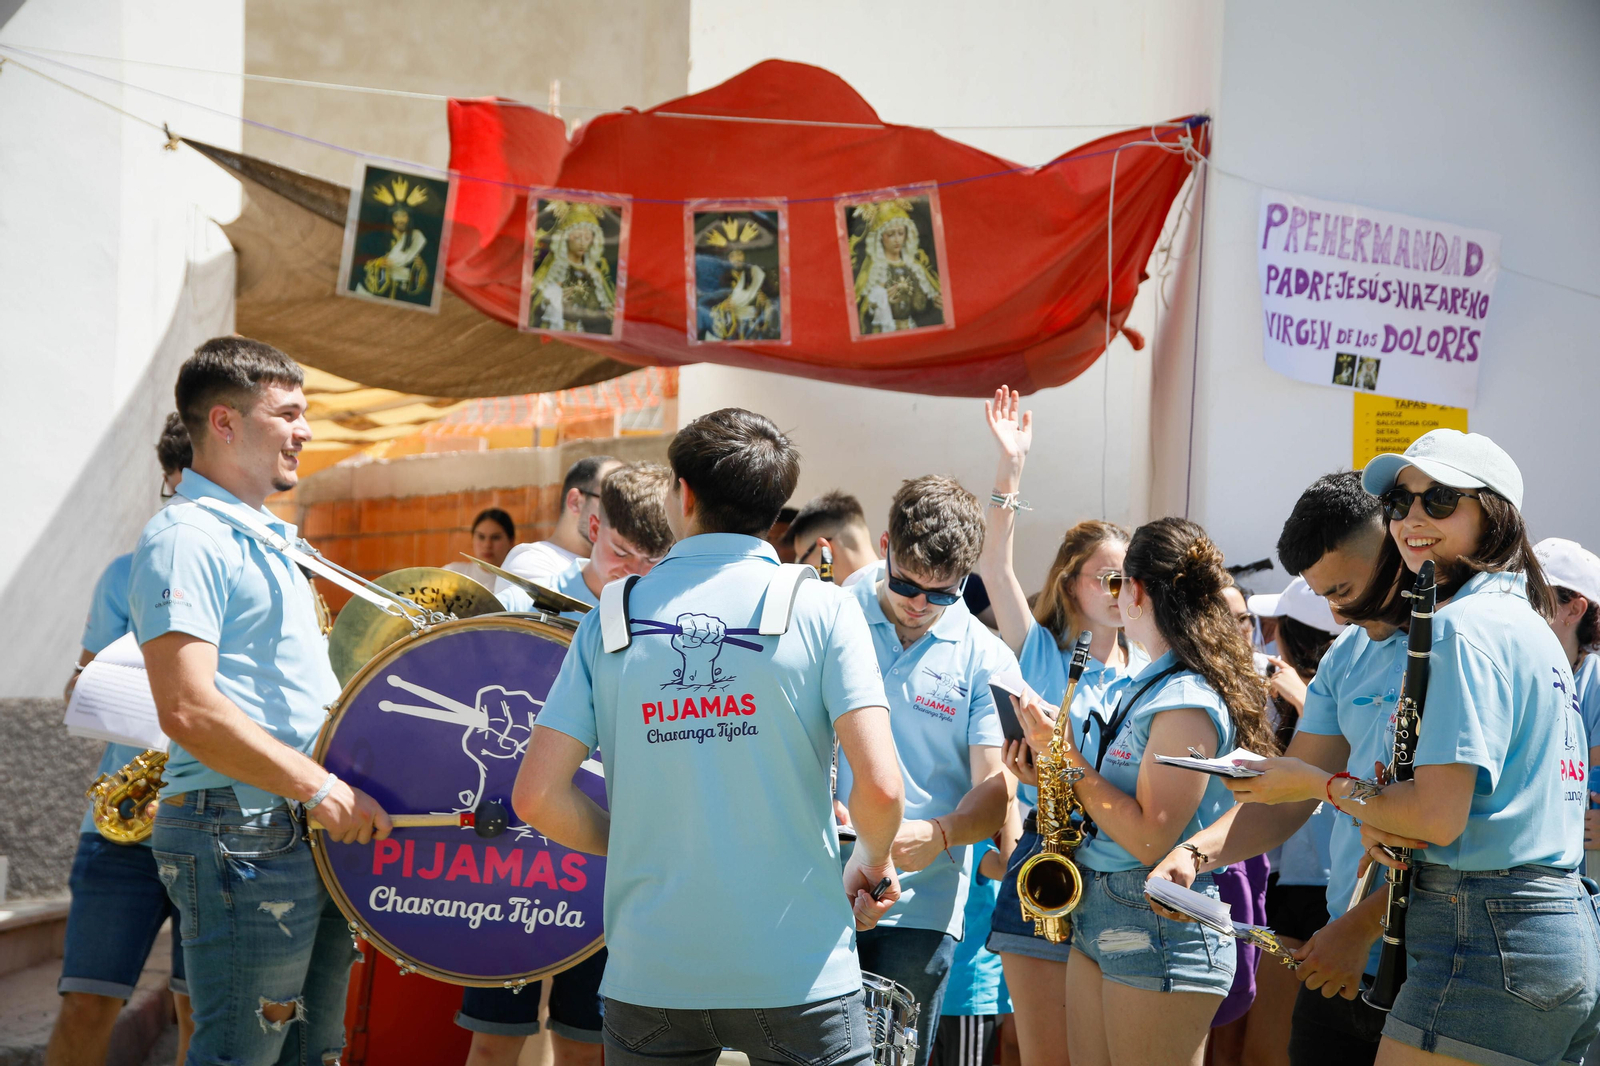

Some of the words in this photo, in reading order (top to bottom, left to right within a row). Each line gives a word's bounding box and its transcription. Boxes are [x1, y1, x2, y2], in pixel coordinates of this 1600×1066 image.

[1262, 203, 1484, 276] PREHERMANDAD
[1265, 310, 1332, 350] VIRGEN
[1336, 328, 1354, 344] DE
[1355, 329, 1378, 347] LOS
[1380, 324, 1481, 363] DOLORES
[1395, 400, 1427, 409] TAPAS
[641, 693, 756, 725] PIJAMAS
[913, 704, 938, 717] Charanga
[915, 695, 956, 716] PIJAMAS
[646, 727, 716, 744] Charanga
[372, 838, 588, 892] PIJAMAS
[368, 885, 504, 929] Charanga
